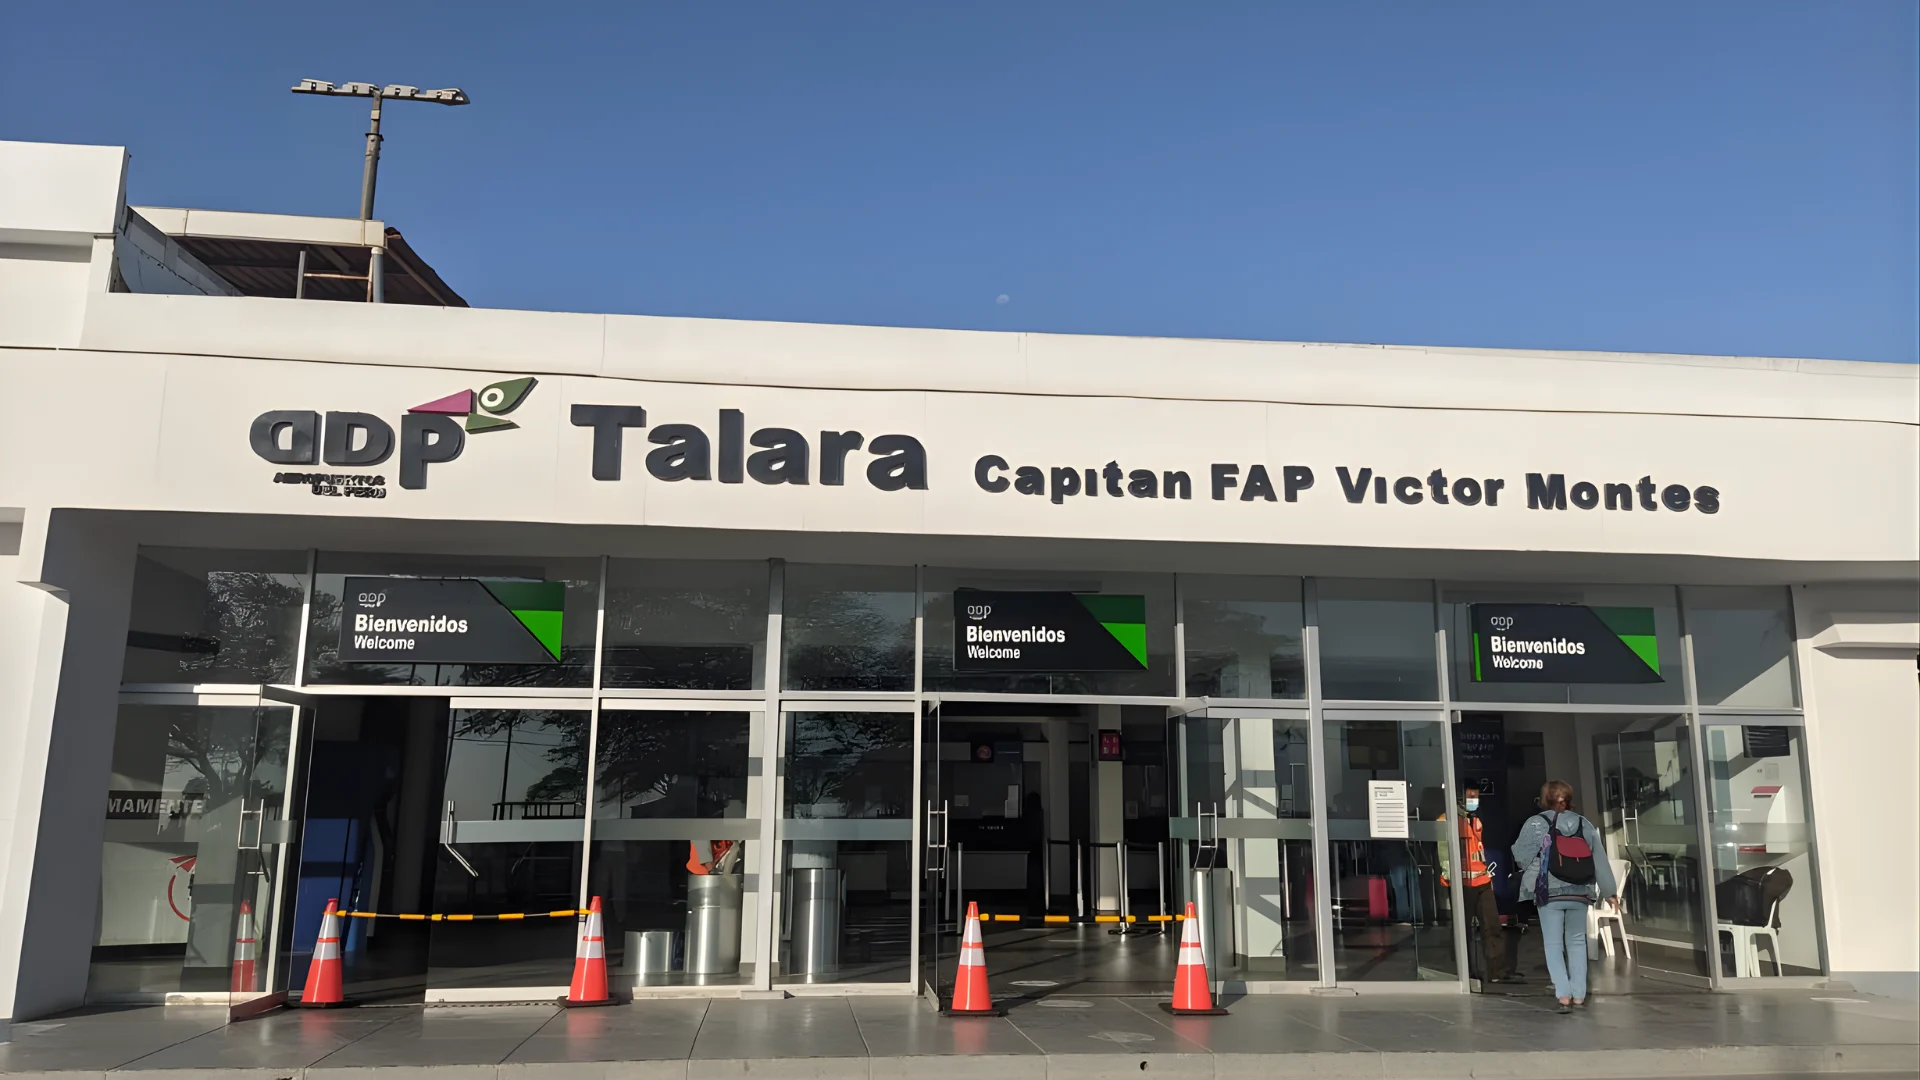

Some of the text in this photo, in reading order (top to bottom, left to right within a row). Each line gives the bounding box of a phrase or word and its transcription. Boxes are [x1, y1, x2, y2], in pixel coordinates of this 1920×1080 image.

[571, 403, 929, 491] Talara
[974, 454, 1720, 514] Capitan FAP Victor Montes
[354, 614, 468, 633] Bienvenidos
[354, 635, 415, 650] Welcome
[966, 625, 1066, 643] Bienvenidos
[967, 645, 1021, 659] Welcome
[1490, 636, 1586, 655] Bienvenidos
[1492, 655, 1544, 669] Welcome
